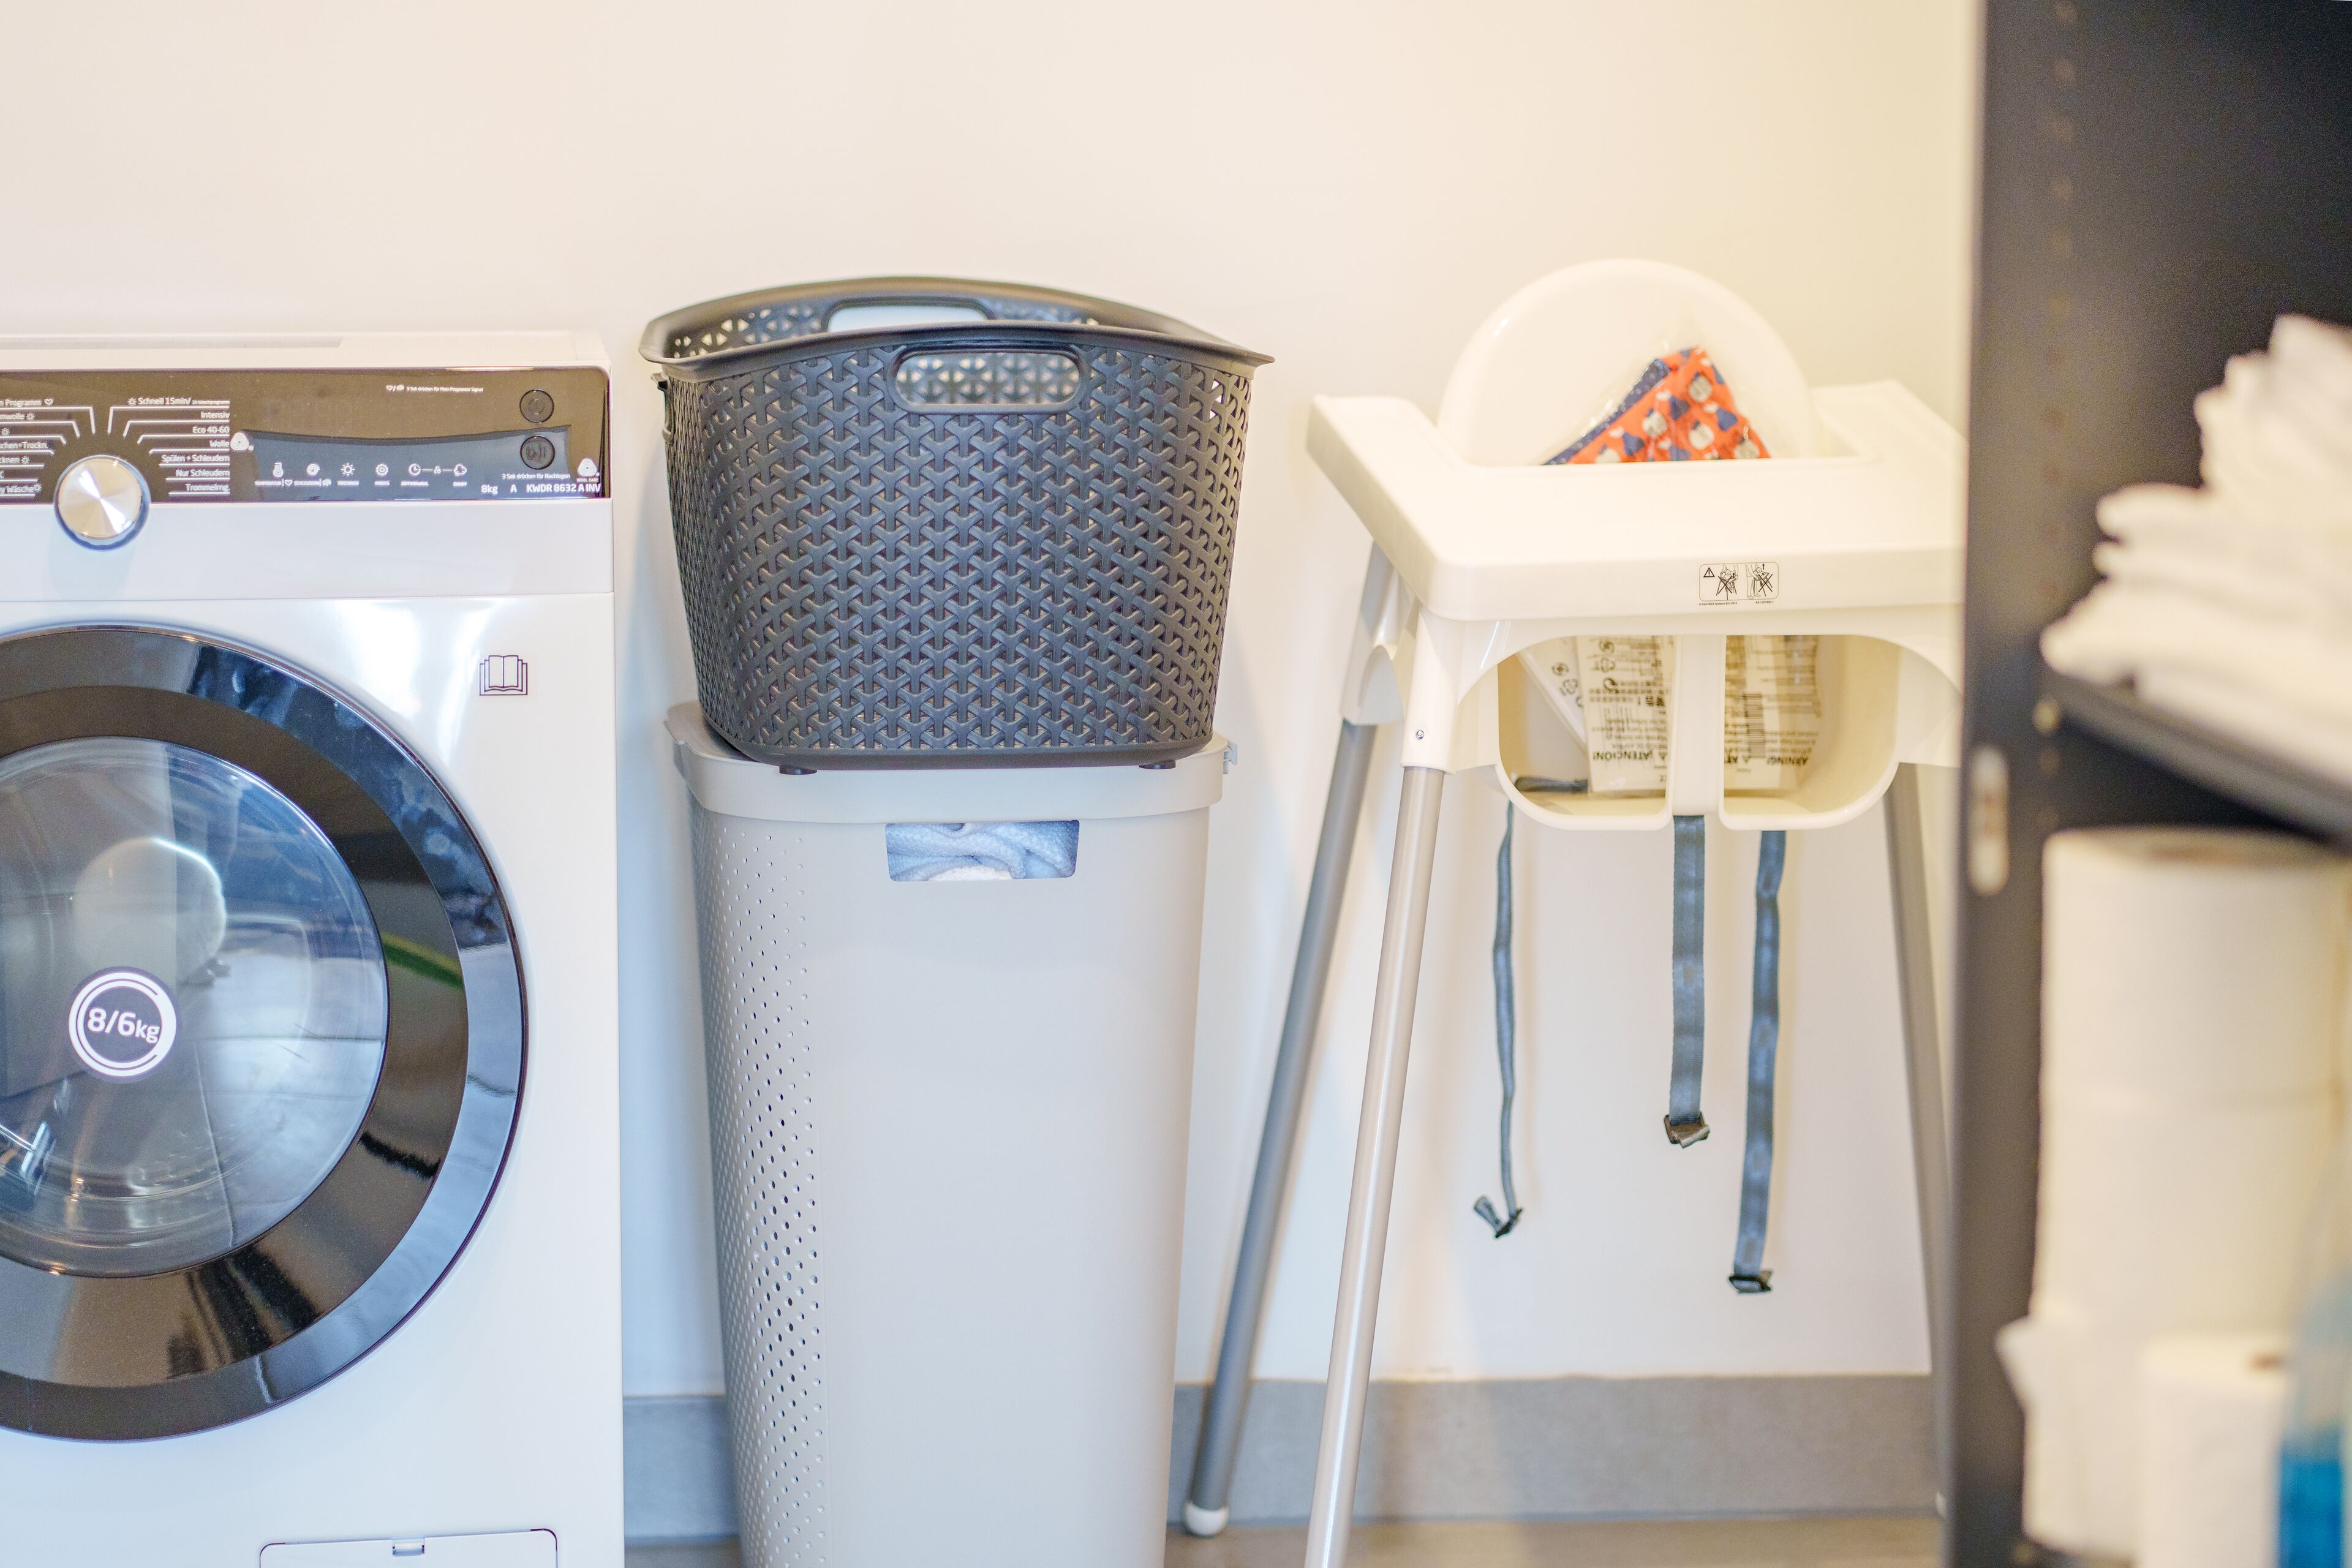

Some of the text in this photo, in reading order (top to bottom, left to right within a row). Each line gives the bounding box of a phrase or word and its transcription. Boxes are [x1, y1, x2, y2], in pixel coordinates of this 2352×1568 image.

[4, 399, 42, 408] Programm
[161, 454, 186, 463] Spülen
[481, 484, 498, 494] 8kg
[527, 484, 552, 493] KWDR
[554, 484, 577, 492] 8632
[578, 484, 585, 492] A
[586, 483, 601, 492] INV
[87, 1008, 160, 1044] 8/6kg
